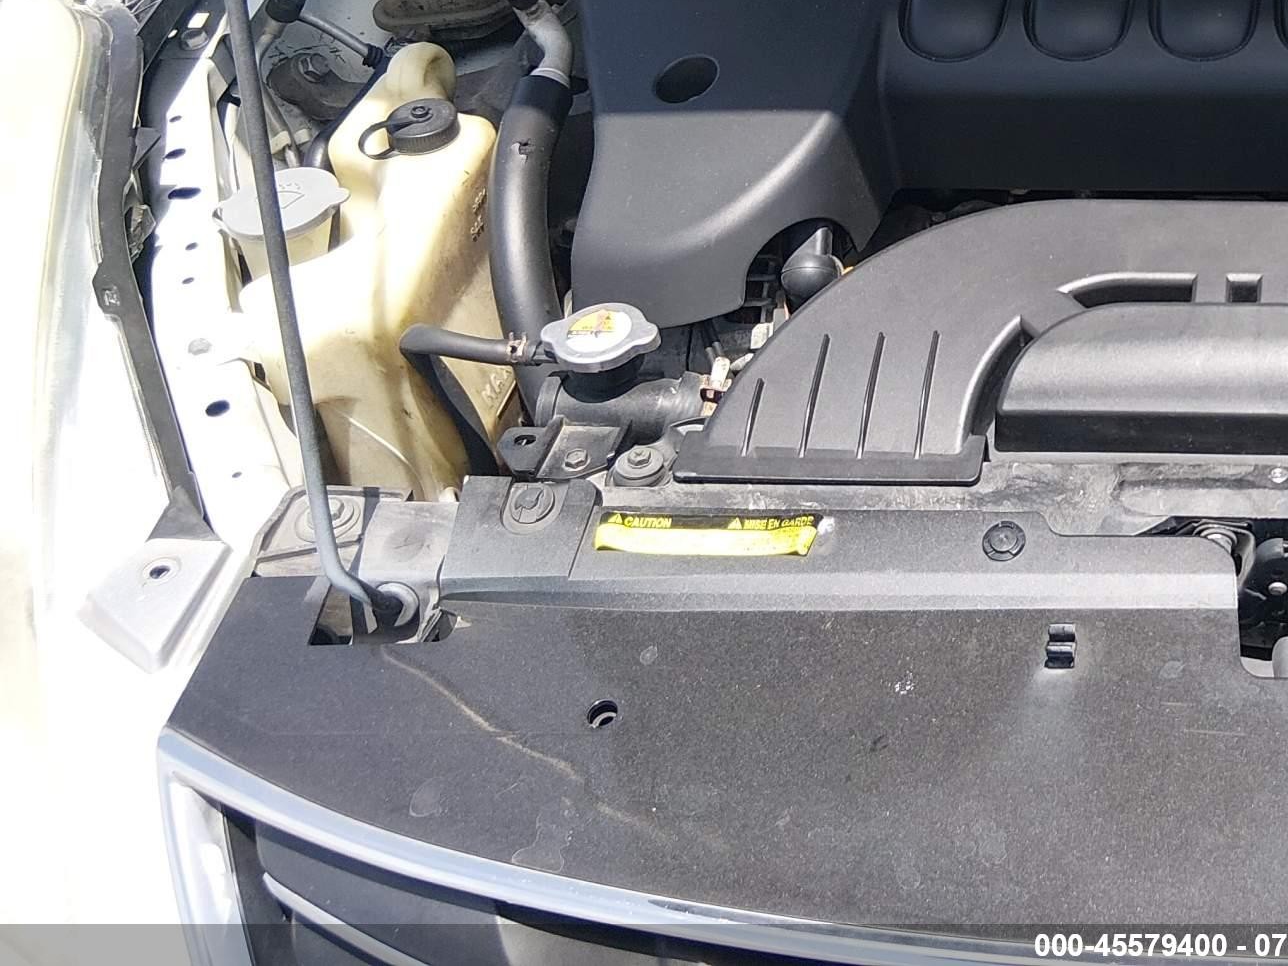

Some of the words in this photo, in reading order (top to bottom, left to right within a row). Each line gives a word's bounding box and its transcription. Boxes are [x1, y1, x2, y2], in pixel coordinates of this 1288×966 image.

[623, 516, 673, 529] CAUTION
[743, 518, 768, 530] MISE
[767, 518, 781, 529] EN
[781, 515, 815, 527] GARDE
